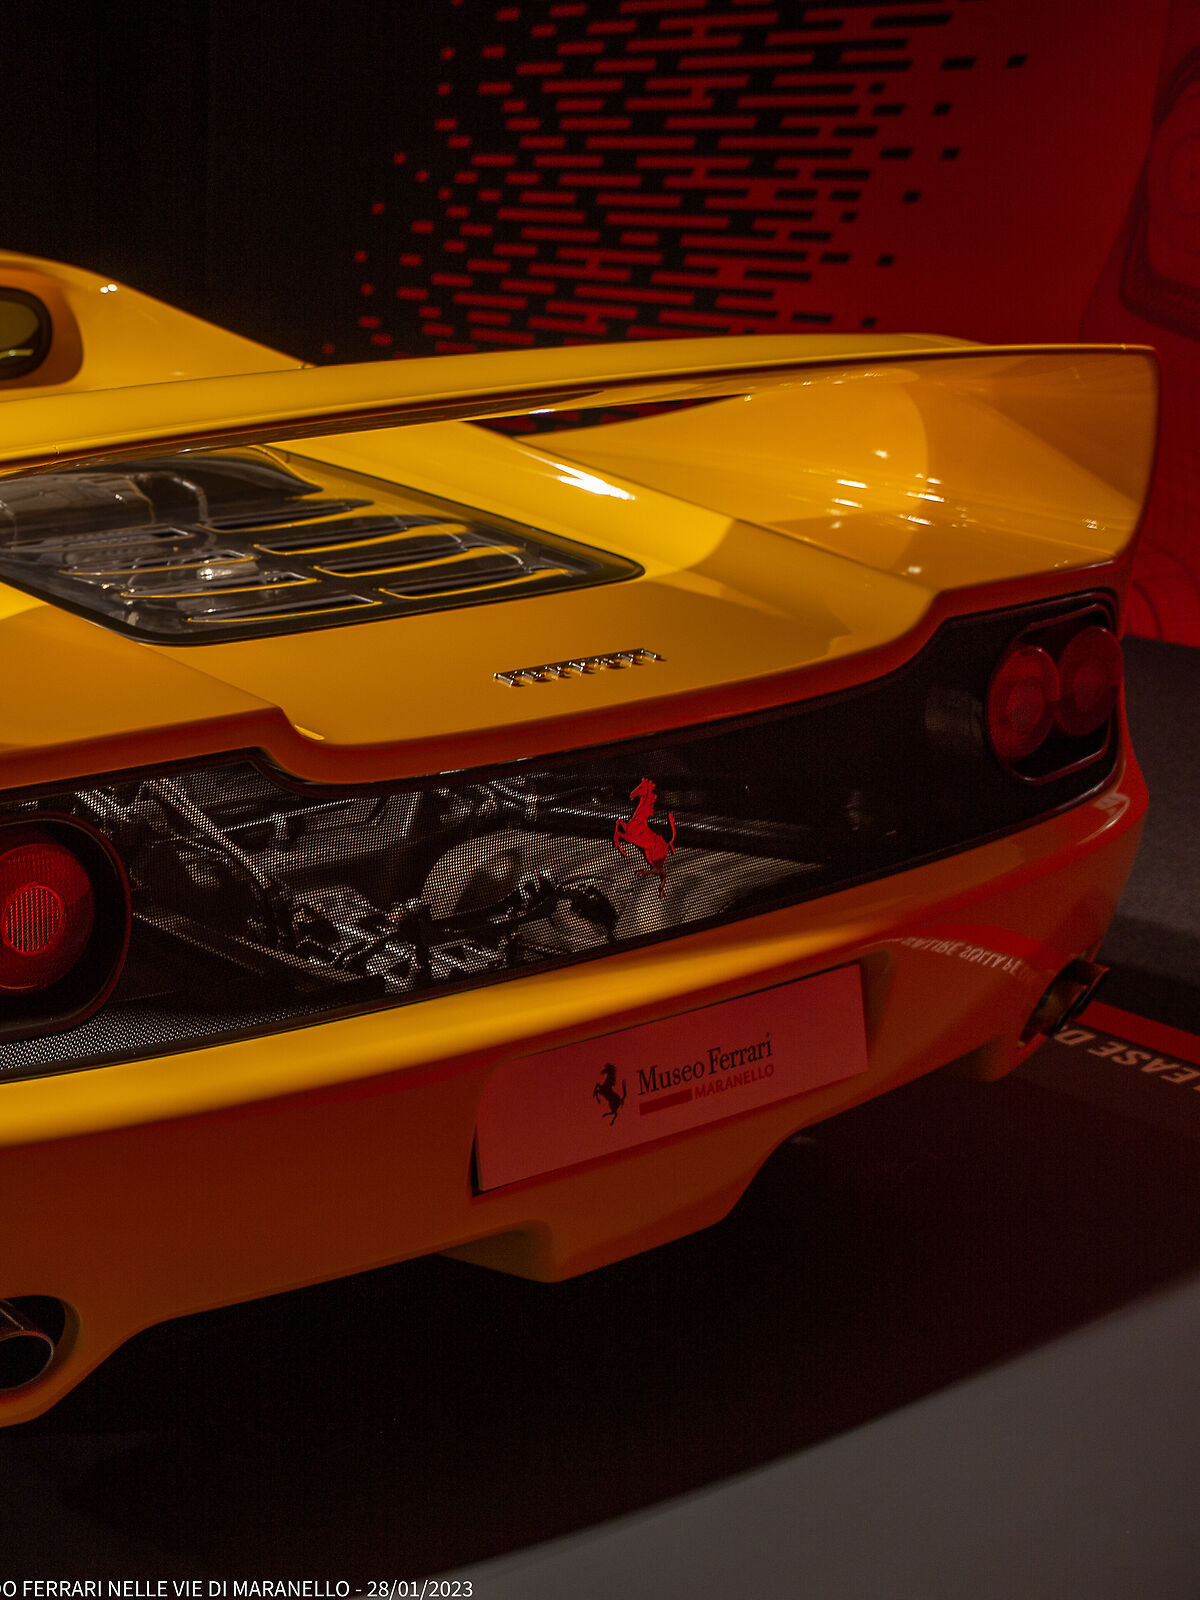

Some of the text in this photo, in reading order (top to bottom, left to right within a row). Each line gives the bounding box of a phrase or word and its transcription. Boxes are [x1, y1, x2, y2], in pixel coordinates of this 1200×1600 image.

[637, 1032, 773, 1096] Museo Ferrari
[694, 1063, 775, 1100] MARANELLO
